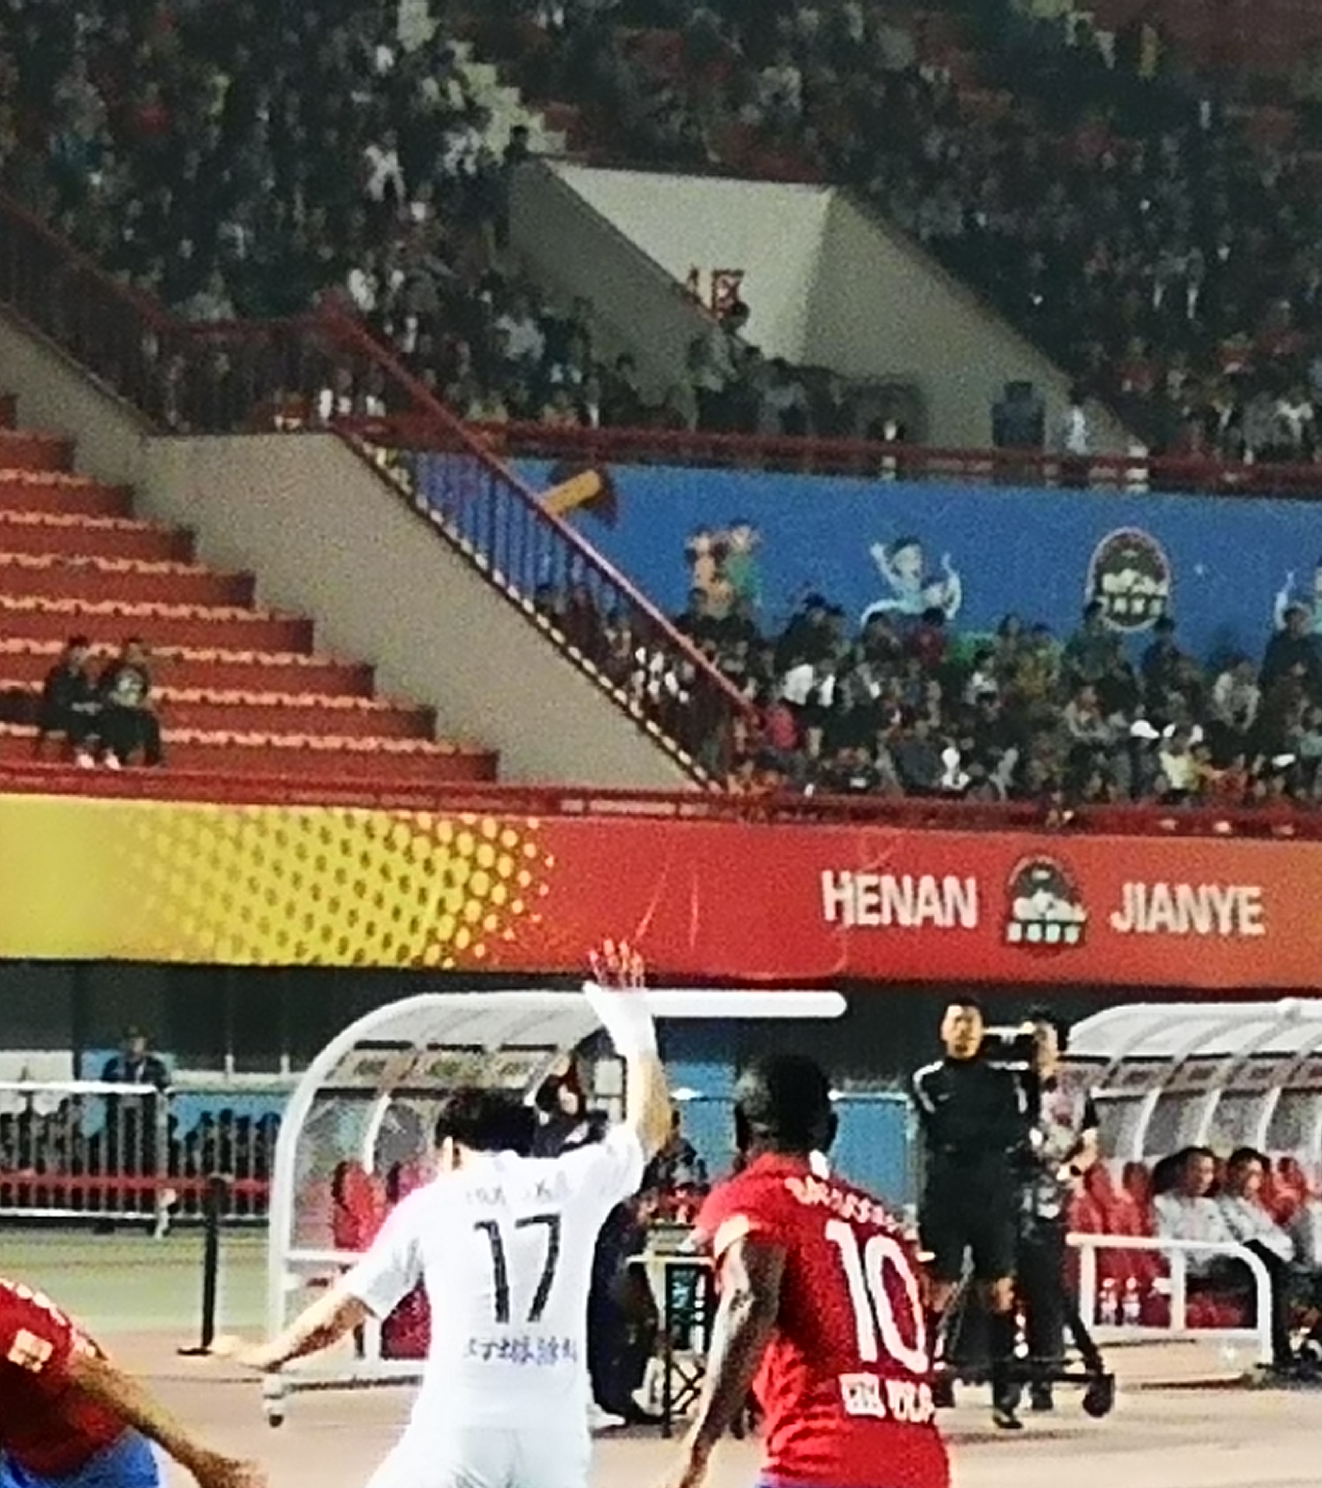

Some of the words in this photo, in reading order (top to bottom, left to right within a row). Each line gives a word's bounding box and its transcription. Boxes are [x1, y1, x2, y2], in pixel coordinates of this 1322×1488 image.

[820, 869, 977, 929] HENAN
[1109, 881, 1266, 937] JIANYE
[473, 1211, 561, 1324] 17
[825, 1219, 929, 1374] 10
